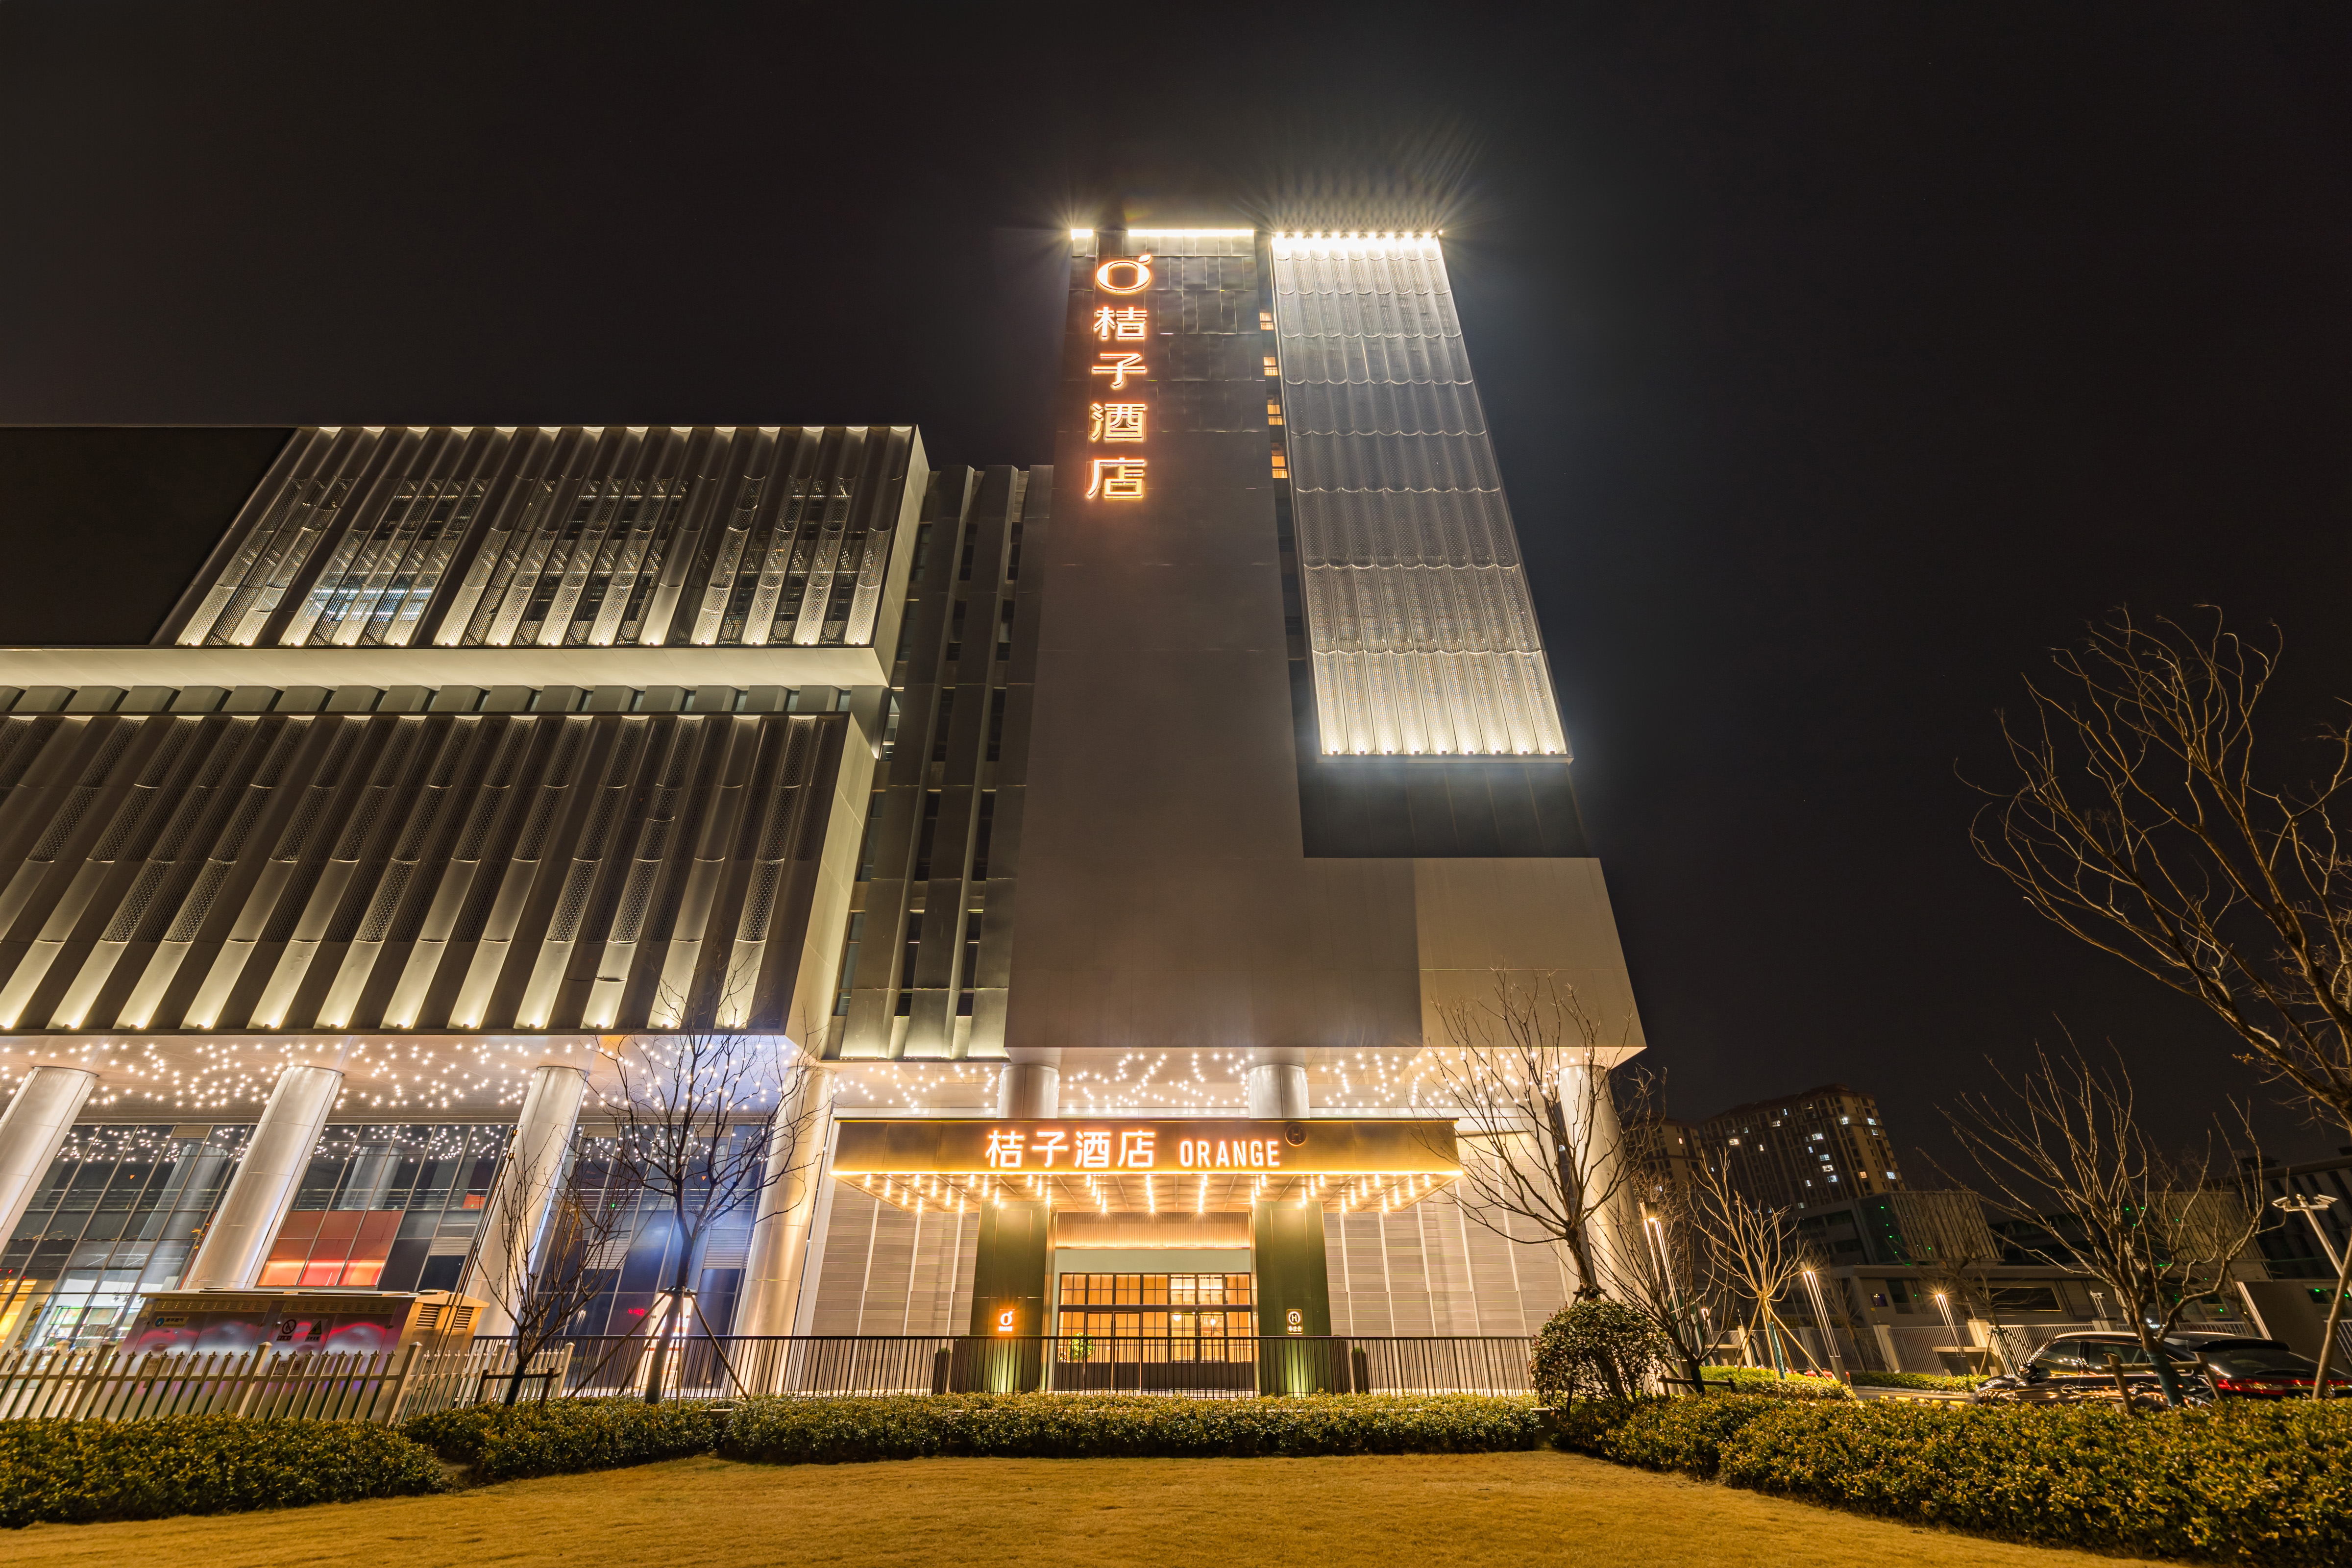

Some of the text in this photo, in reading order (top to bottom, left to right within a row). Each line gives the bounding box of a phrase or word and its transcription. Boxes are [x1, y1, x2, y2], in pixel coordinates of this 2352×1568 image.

[1086, 306, 1148, 498] 桔子酒店
[985, 1130, 1280, 1168] 桔子酒店 ORANGE
